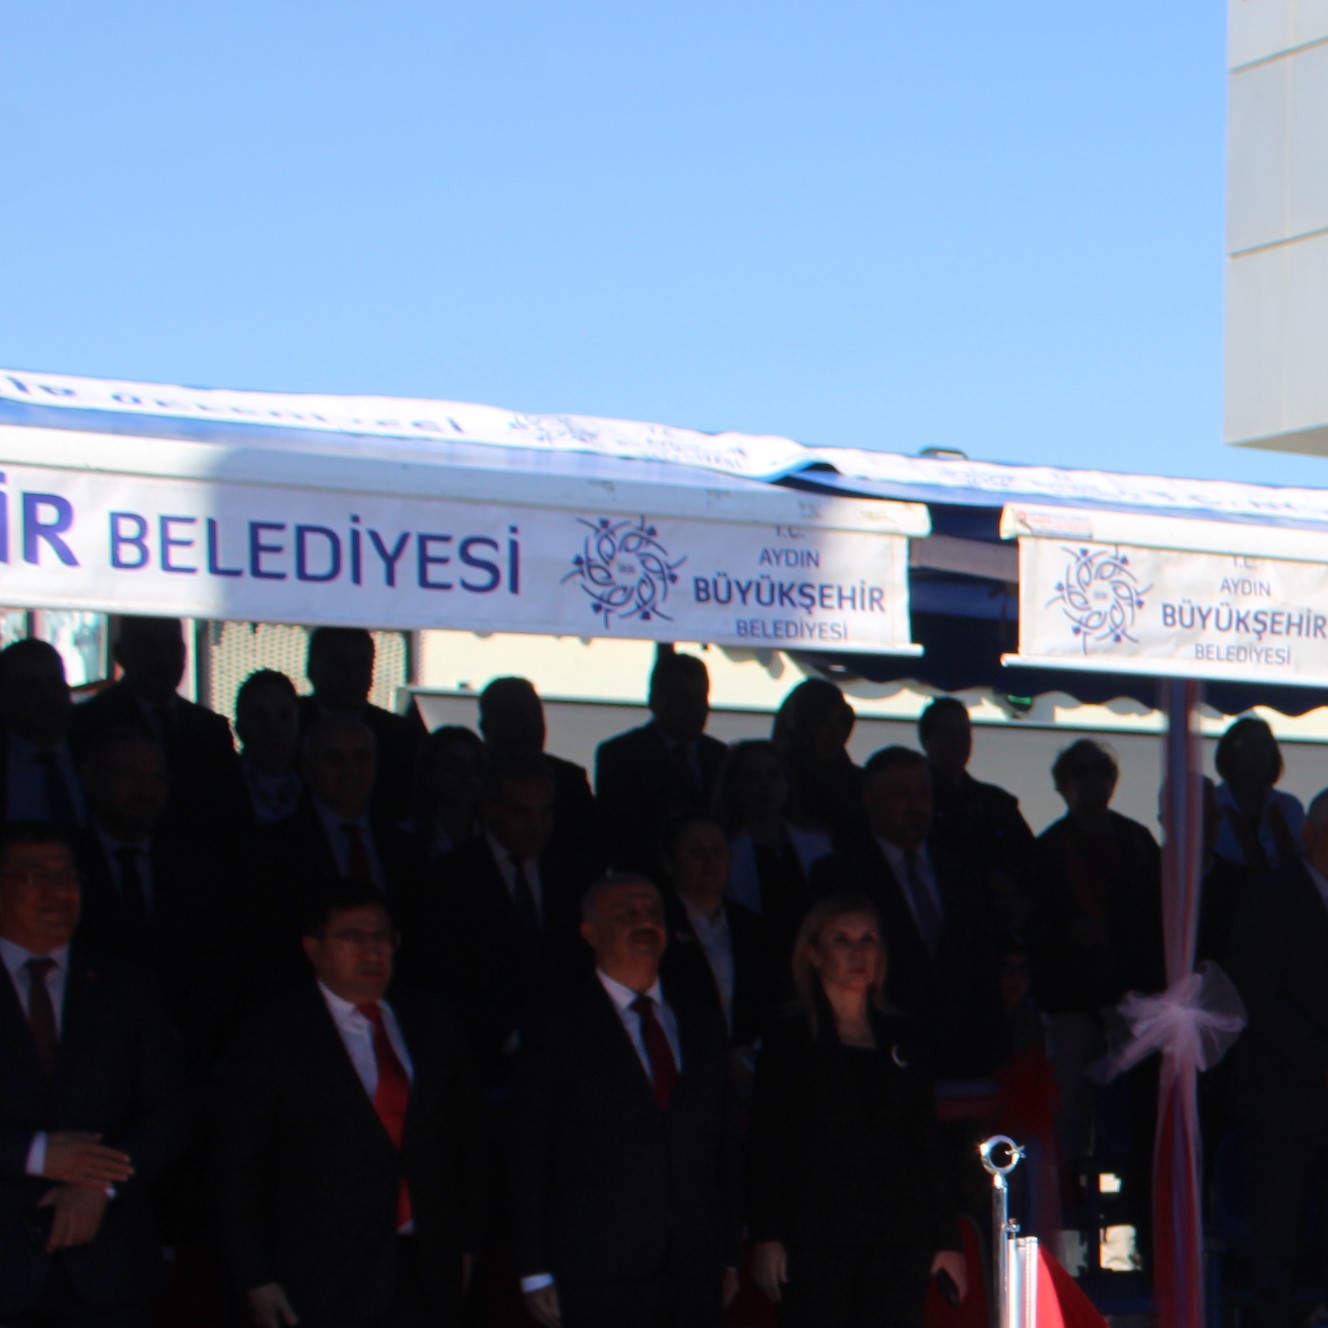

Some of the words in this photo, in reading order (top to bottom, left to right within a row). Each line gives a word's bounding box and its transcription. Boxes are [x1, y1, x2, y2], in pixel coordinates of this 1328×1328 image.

[109, 511, 520, 596] BELEDİYESİ
[758, 548, 820, 568] AYDIN
[693, 571, 886, 615] BÜYÜKŞEHİR
[1220, 577, 1272, 597] AYDIN
[736, 617, 848, 640] BELEDİYESİ
[1161, 599, 1328, 640] BÜYÜKŞEHİR
[1194, 642, 1292, 666] BELEDİYESİ
